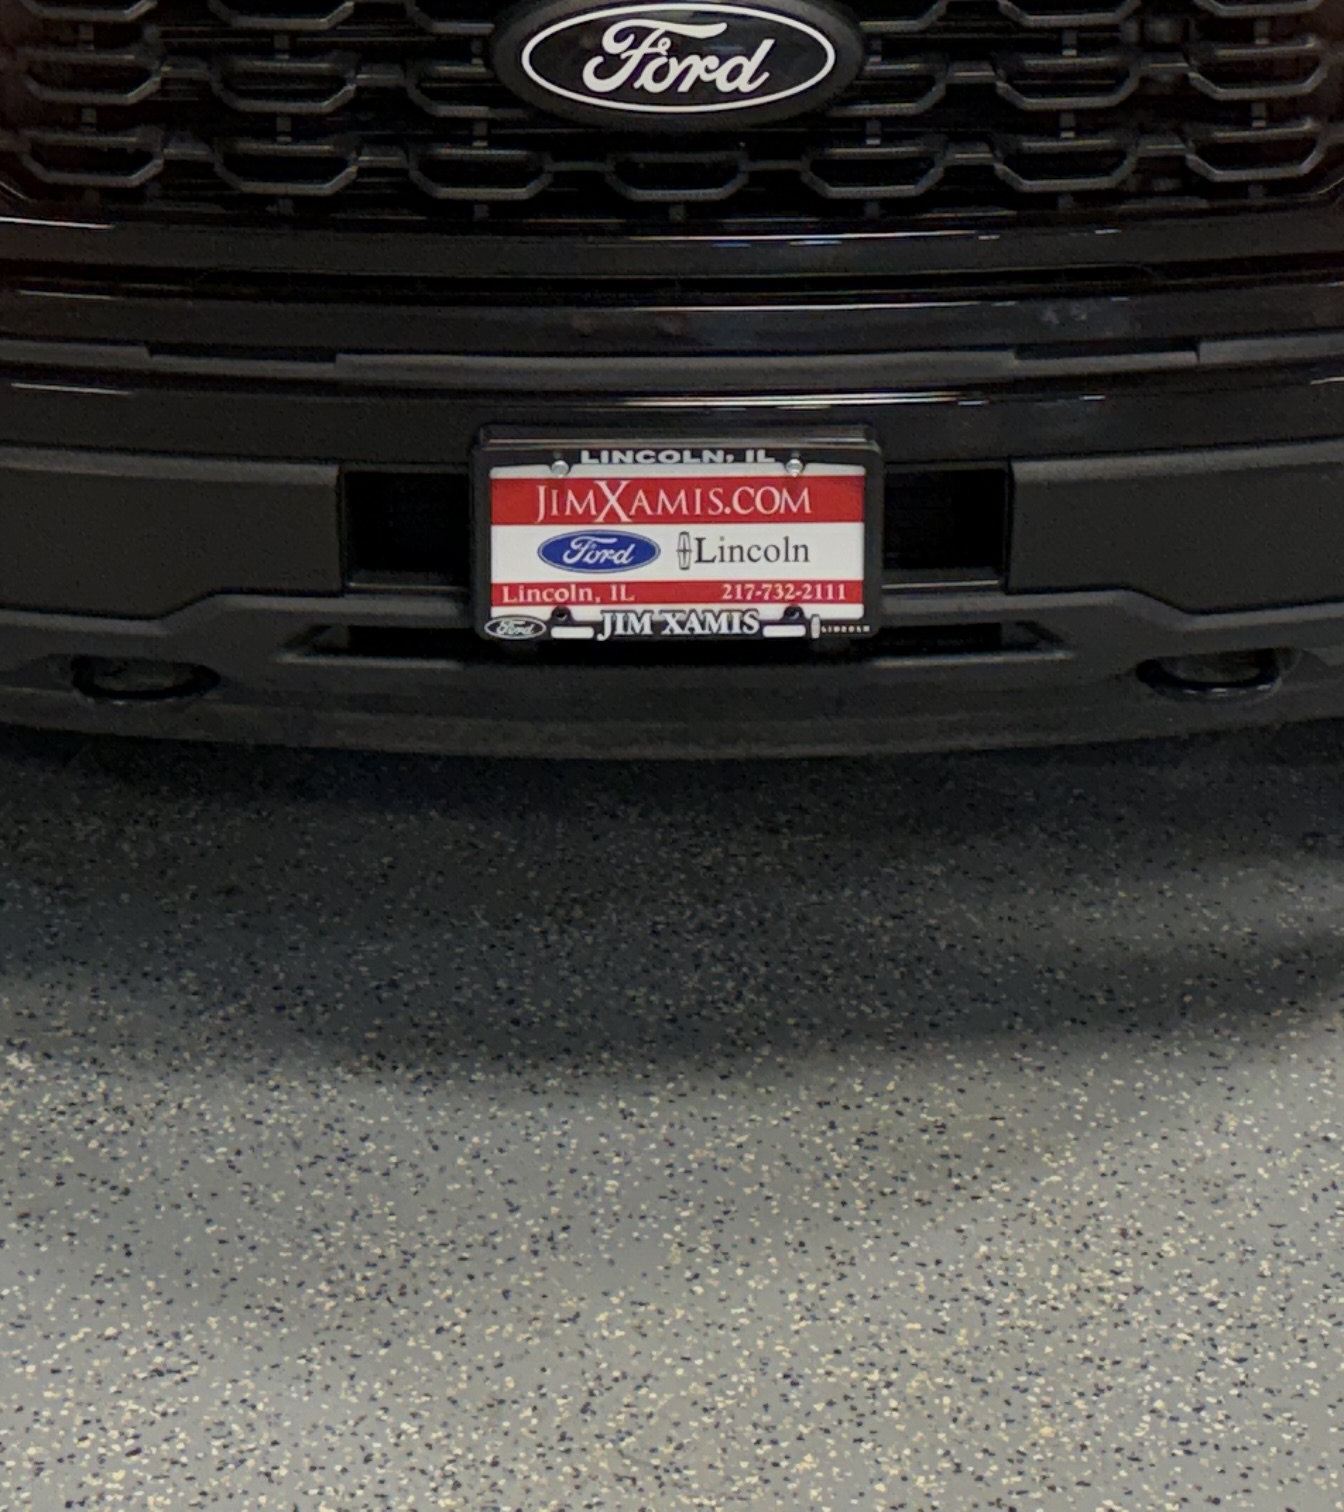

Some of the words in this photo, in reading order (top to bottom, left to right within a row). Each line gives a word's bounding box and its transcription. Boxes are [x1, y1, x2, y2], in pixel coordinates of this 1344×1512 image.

[582, 18, 775, 93] Ford
[580, 449, 735, 464] LINCOLN,
[745, 449, 776, 463] IL
[536, 479, 812, 523] JIMXAMIS.COM
[562, 535, 636, 565] Ford
[694, 536, 810, 564] Lincoln
[502, 585, 601, 603] Lincoln,
[610, 585, 636, 601] IL
[722, 583, 846, 600] 217-732-2111
[597, 611, 654, 641] JIM
[659, 609, 760, 635] XAMIS
